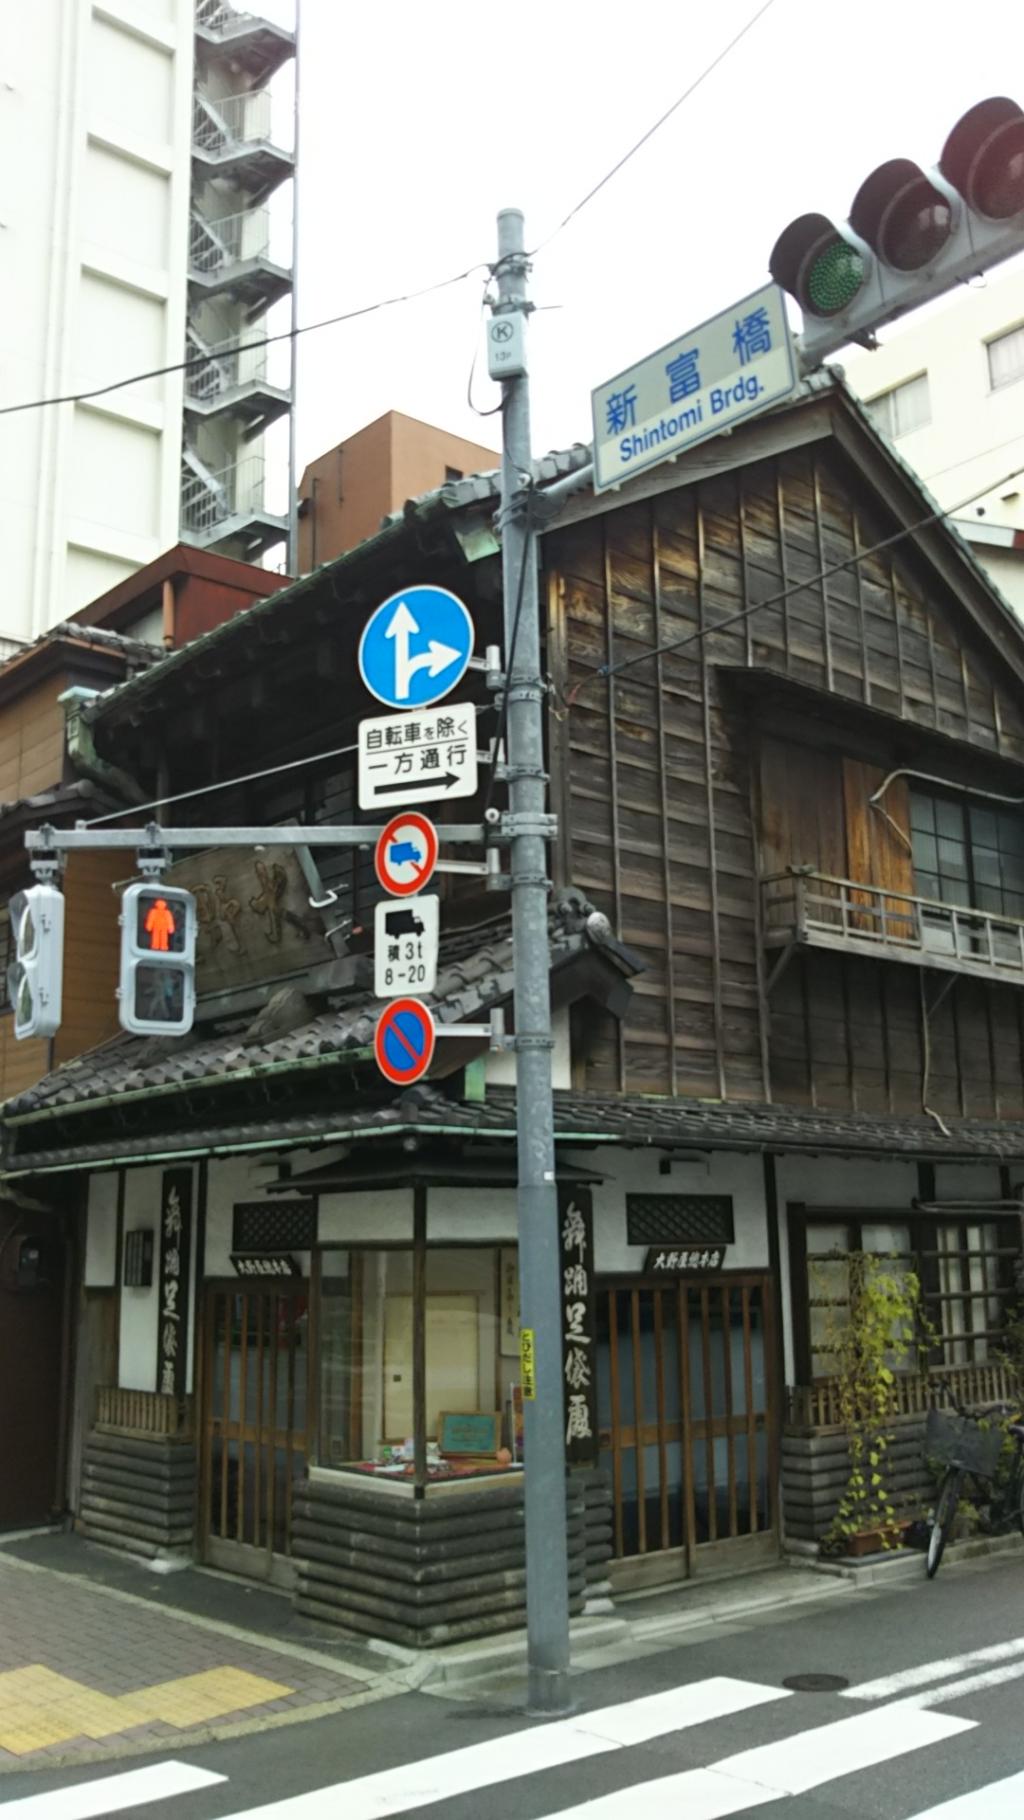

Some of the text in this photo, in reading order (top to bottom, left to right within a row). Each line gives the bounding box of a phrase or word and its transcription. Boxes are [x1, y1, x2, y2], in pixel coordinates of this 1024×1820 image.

[606, 307, 772, 435] 新富橋
[620, 373, 765, 463] Shintomi Brdg.
[366, 718, 468, 749] 自転車を除く
[367, 748, 468, 776] 一方通行
[384, 965, 426, 986] 8-20
